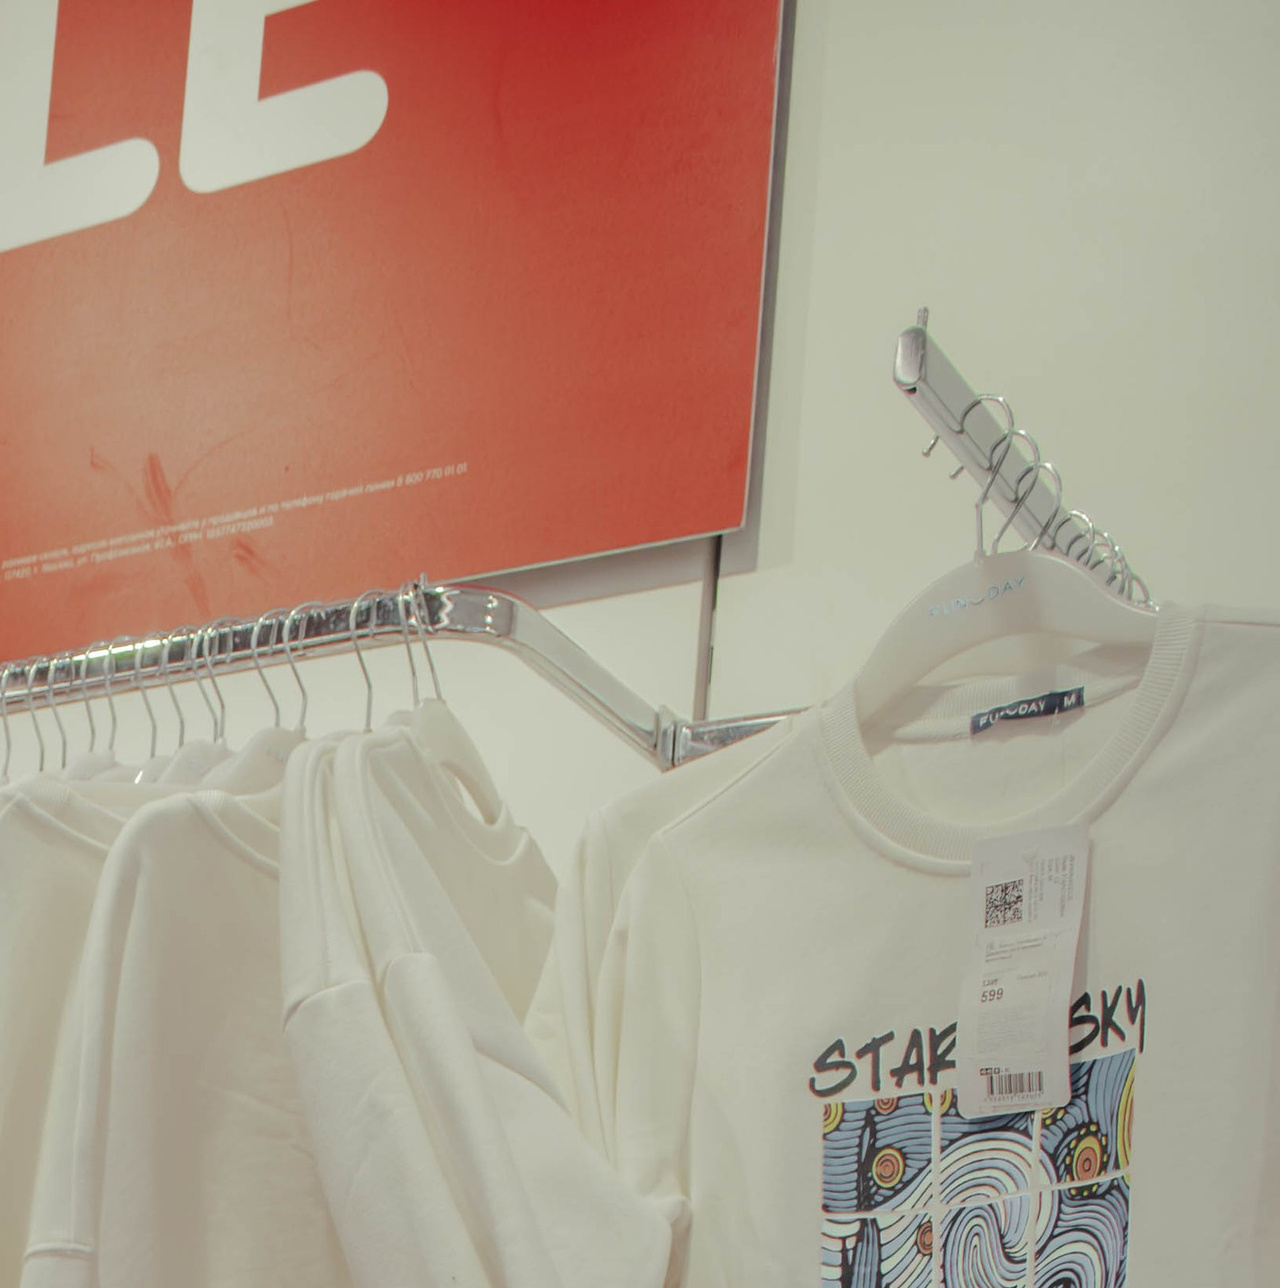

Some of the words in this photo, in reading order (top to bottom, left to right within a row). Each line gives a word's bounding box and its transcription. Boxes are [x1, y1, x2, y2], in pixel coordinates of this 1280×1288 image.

[1063, 692, 1078, 708] M
[981, 987, 1004, 1003] 599
[809, 1021, 959, 1098] STAR
[1069, 978, 1148, 1054] SKY
